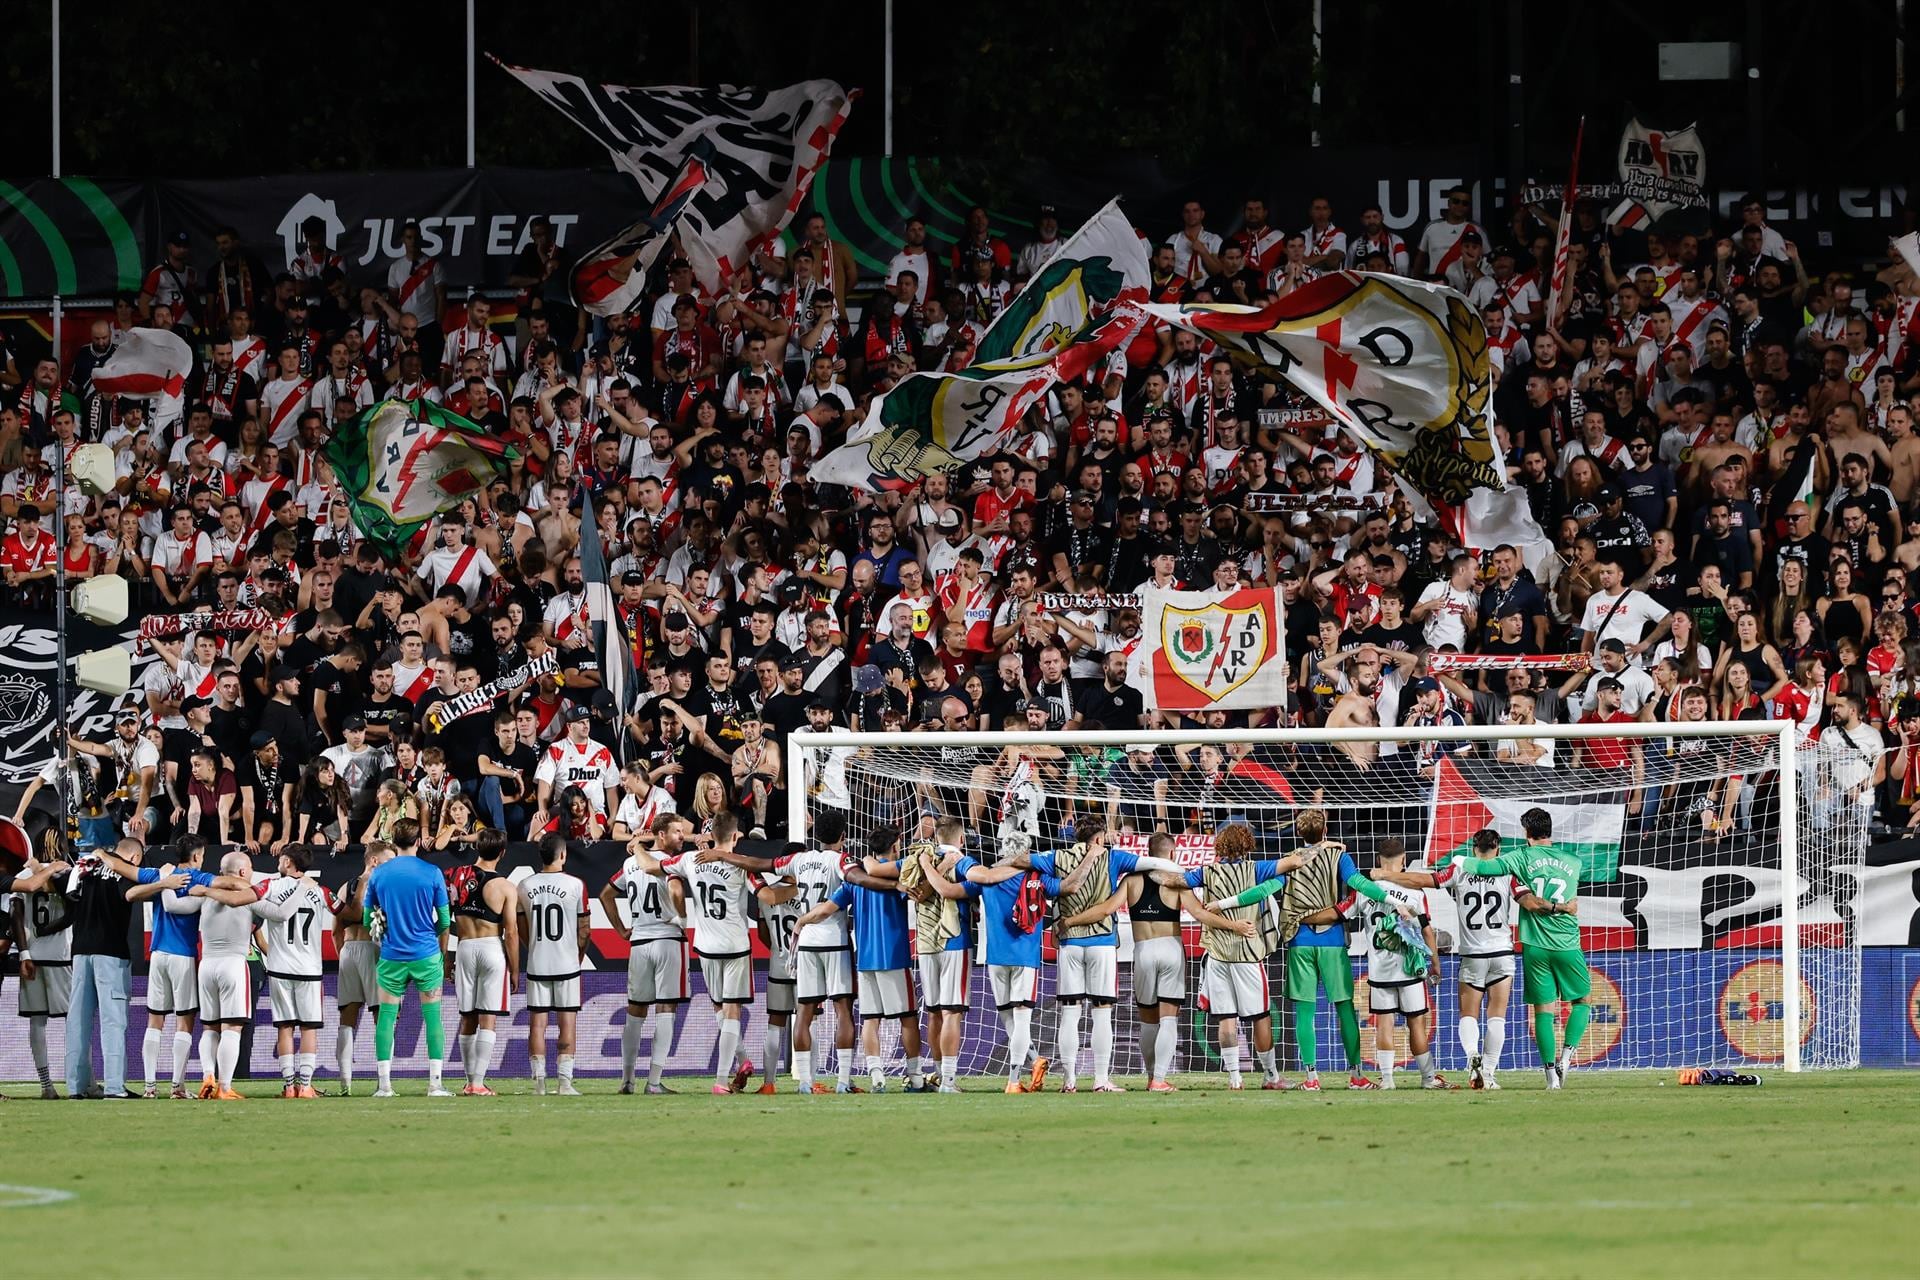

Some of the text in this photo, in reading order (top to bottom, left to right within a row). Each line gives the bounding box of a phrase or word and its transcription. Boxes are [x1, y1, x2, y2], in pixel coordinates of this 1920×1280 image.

[358, 214, 579, 267] JUST EAT
[1258, 408, 1332, 425] IMPRES
[1596, 537, 1633, 549] DIGI
[1221, 613, 1261, 684] ADRV
[694, 862, 731, 880] GUMBAU
[527, 884, 567, 900] CAMELLO
[627, 881, 662, 918] 24
[696, 881, 727, 920] 15
[1463, 891, 1503, 930] 22
[287, 907, 315, 945] 17
[532, 903, 564, 942] 10
